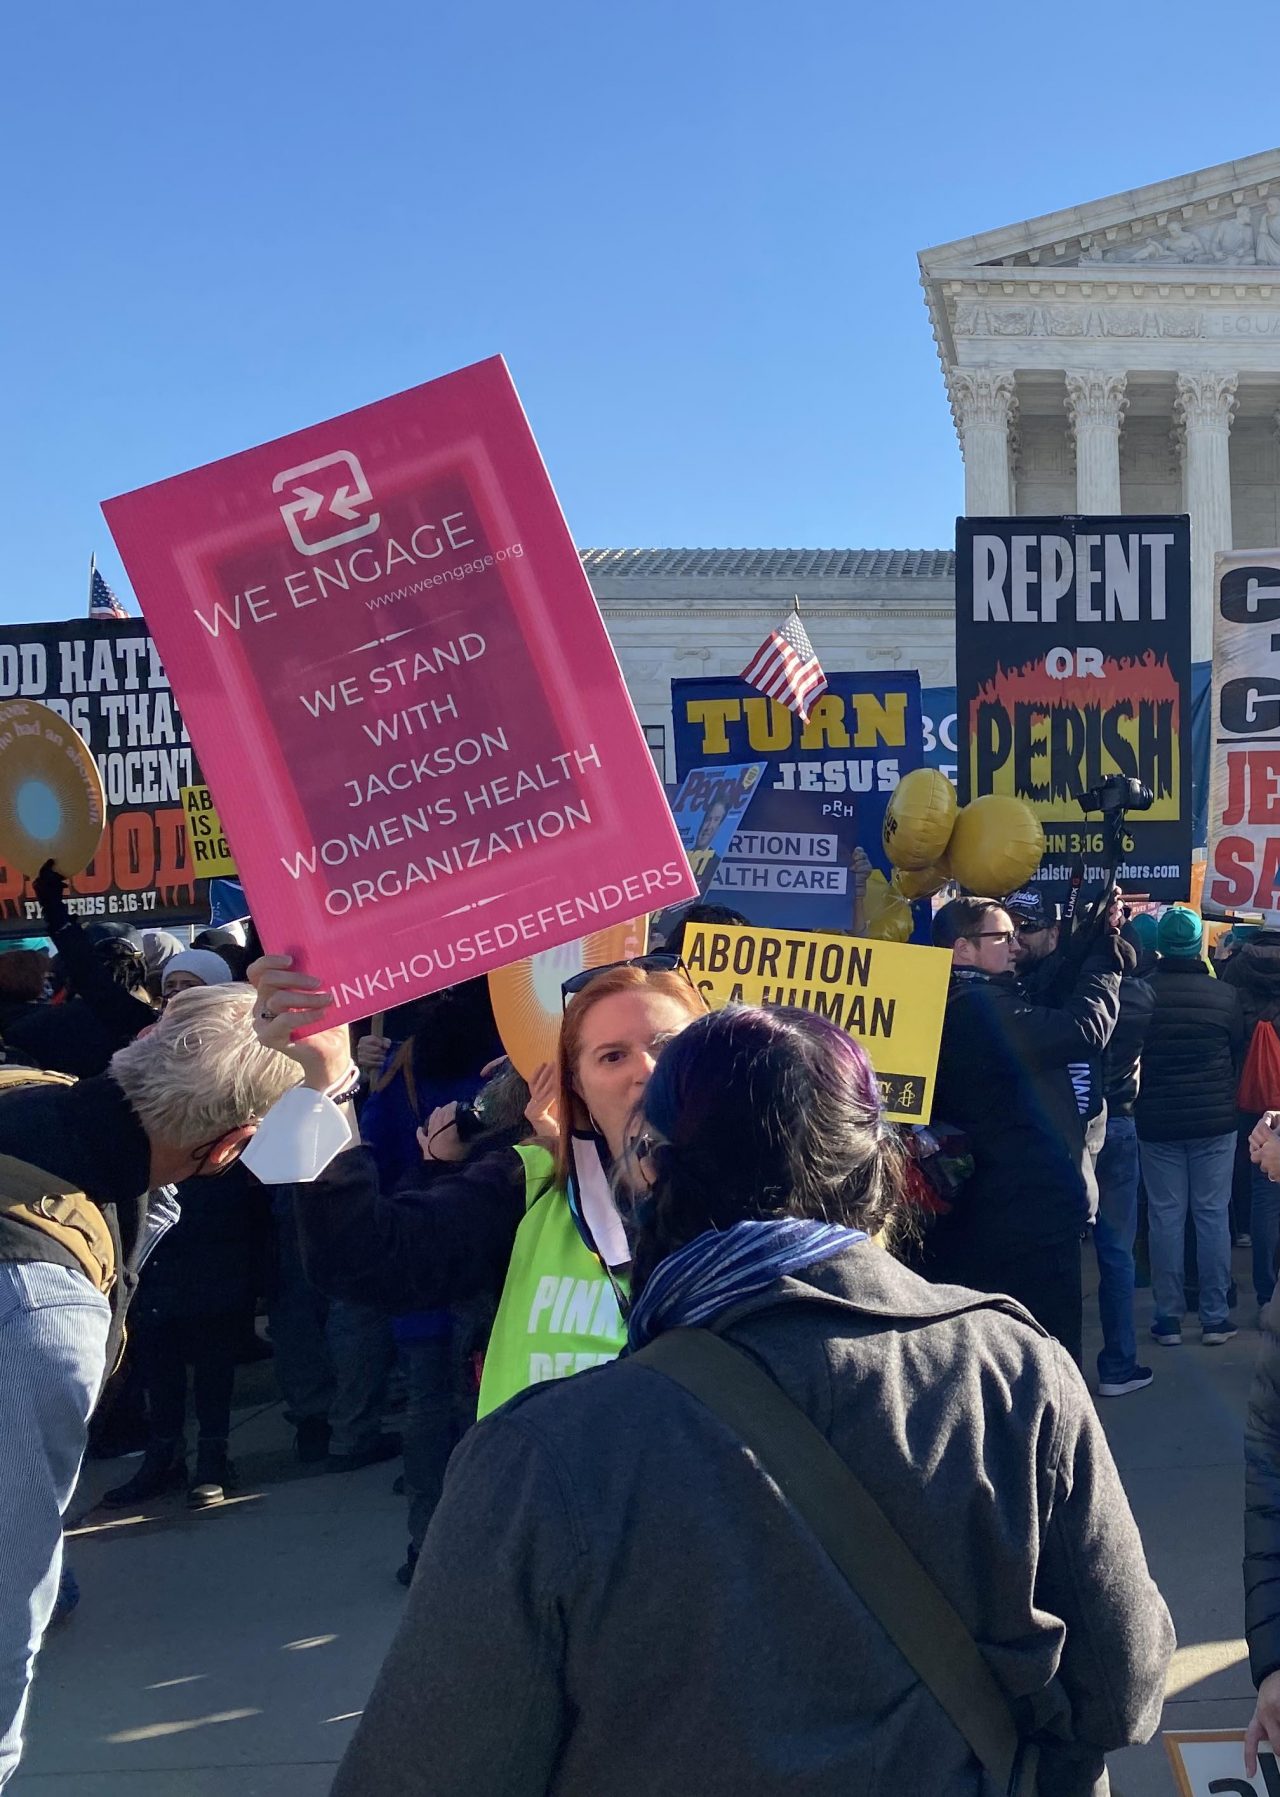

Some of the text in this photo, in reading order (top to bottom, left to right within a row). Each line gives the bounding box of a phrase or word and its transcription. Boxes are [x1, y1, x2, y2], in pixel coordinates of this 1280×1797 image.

[194, 512, 475, 638] WE ENGAGE
[364, 541, 525, 611] www.weengage.org
[972, 533, 1175, 623] REPENT
[0, 643, 48, 697] OD
[299, 632, 486, 718] WE STAND
[1045, 646, 1107, 680] OR
[363, 693, 459, 747] WITH
[686, 693, 908, 754] TURN
[345, 726, 510, 808] JACKSON
[773, 759, 900, 793] JESUS
[974, 698, 1174, 804] PERISH
[191, 815, 212, 837] IS
[280, 743, 602, 882] WOMEN'S HEALTH
[324, 799, 592, 917] ORGANIZATION
[729, 834, 830, 857] RTION IS
[108, 891, 157, 913] 6:16-17
[713, 866, 840, 890] ALTH CARE
[1065, 887, 1080, 918] LUMIX
[330, 861, 683, 1009] INKHOUSEDEFENDERS
[687, 932, 873, 987] ABORTION
